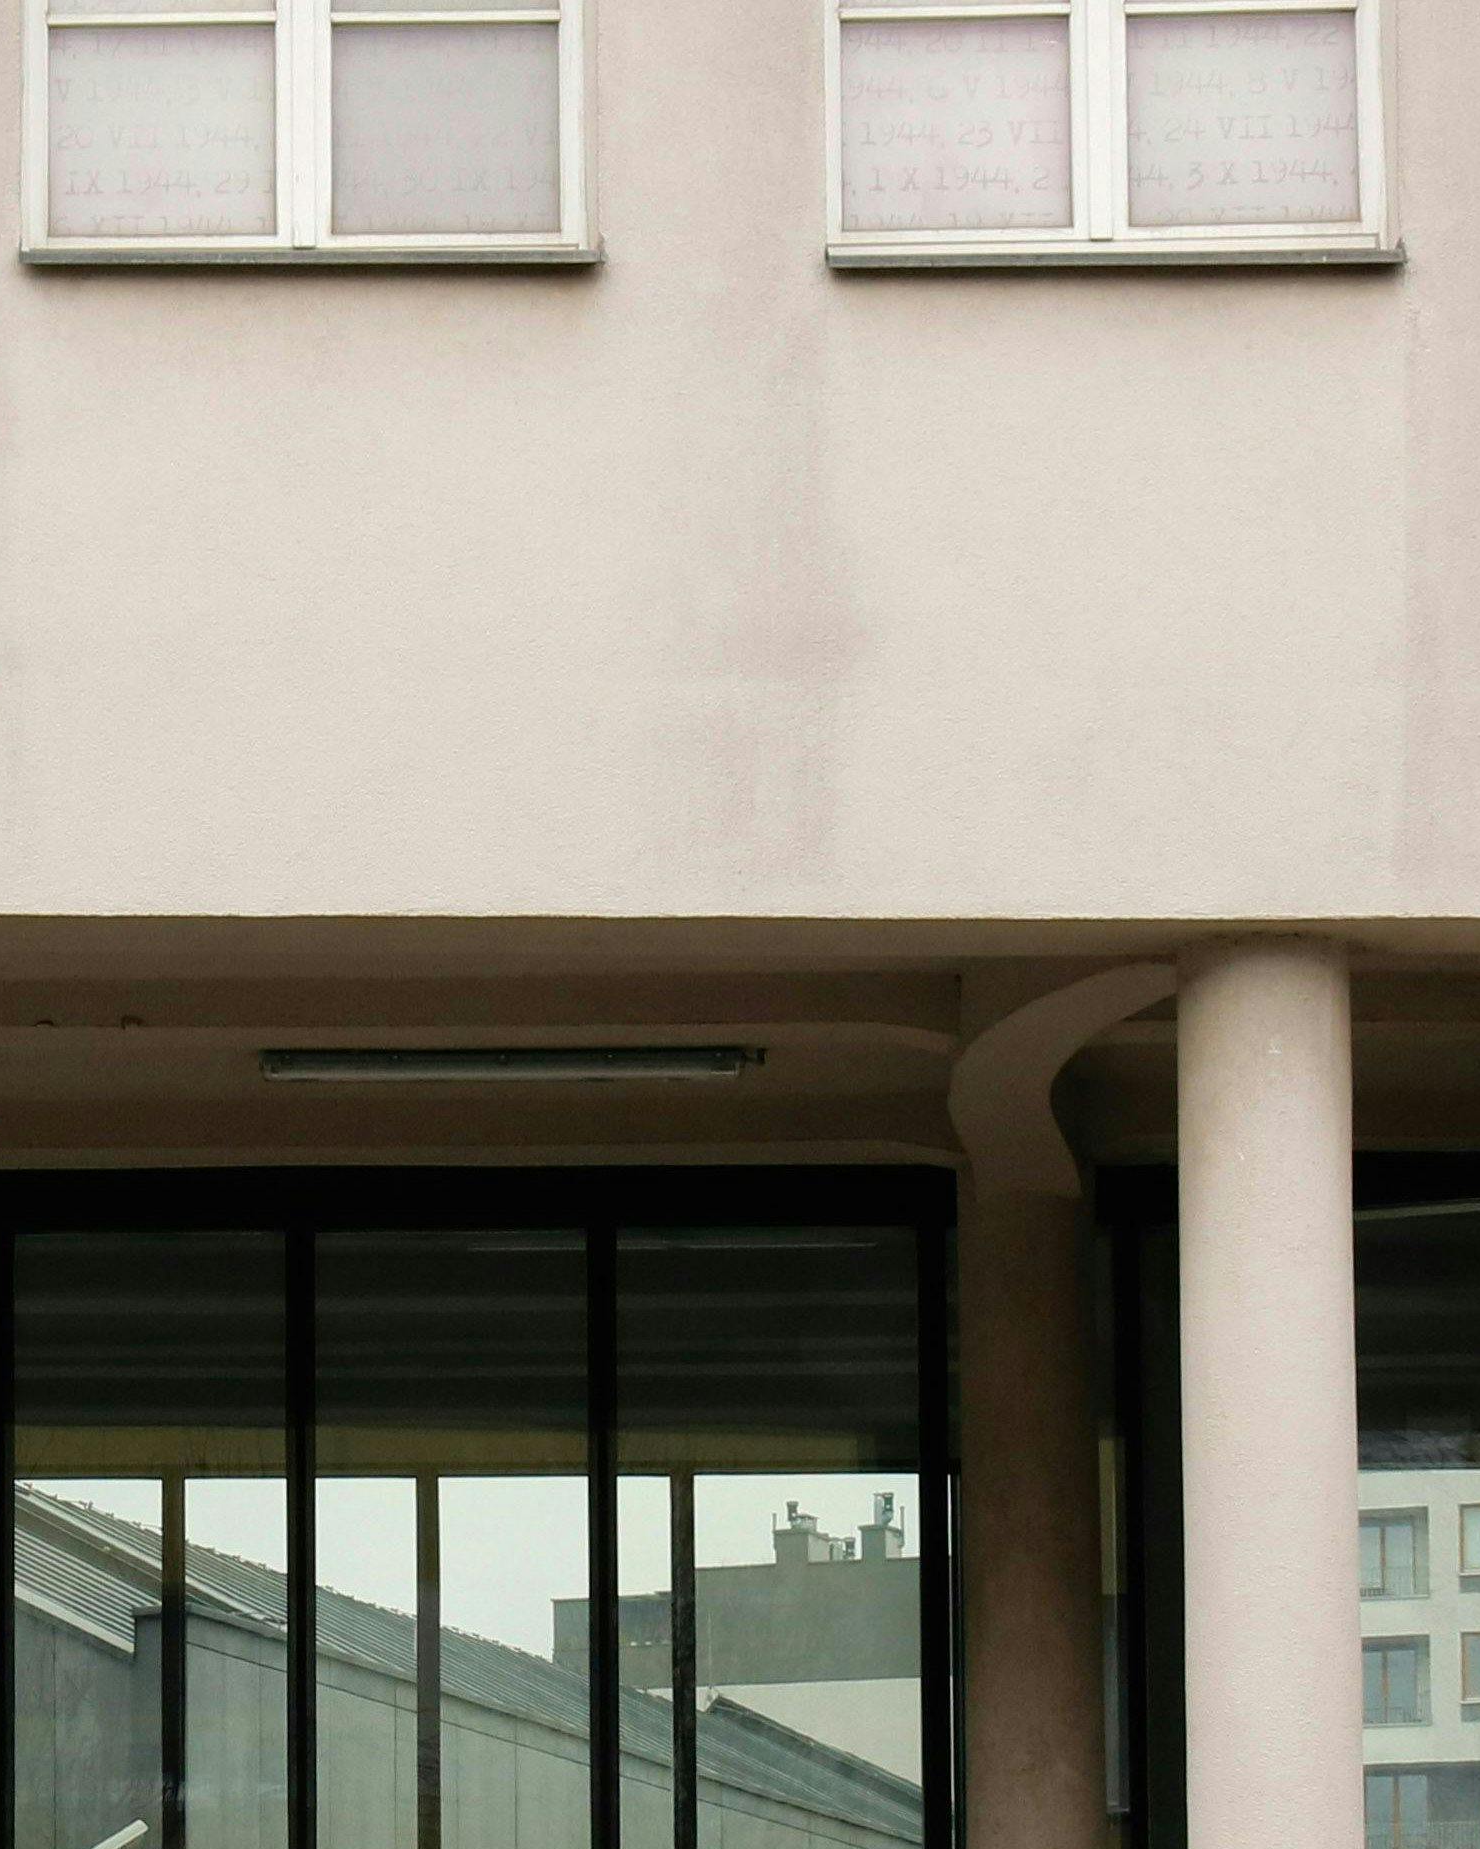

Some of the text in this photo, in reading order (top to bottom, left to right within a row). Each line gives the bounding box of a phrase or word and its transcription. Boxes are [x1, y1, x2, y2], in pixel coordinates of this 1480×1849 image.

[55, 78, 73, 102] V
[216, 77, 233, 101] V
[962, 75, 982, 100] V
[1280, 67, 1300, 91] V
[58, 125, 94, 149] 20
[108, 123, 159, 149] VII
[958, 120, 994, 149] 23
[1006, 119, 1063, 145] VII
[1163, 117, 1207, 142] 24
[1215, 113, 1274, 139] VII
[64, 170, 104, 196] IX
[213, 169, 251, 195] 29
[451, 166, 490, 192] IX
[870, 166, 887, 191] 1
[900, 166, 922, 191] X
[1031, 165, 1051, 191] 2
[1186, 161, 1206, 191] 3
[1216, 160, 1239, 186] X
